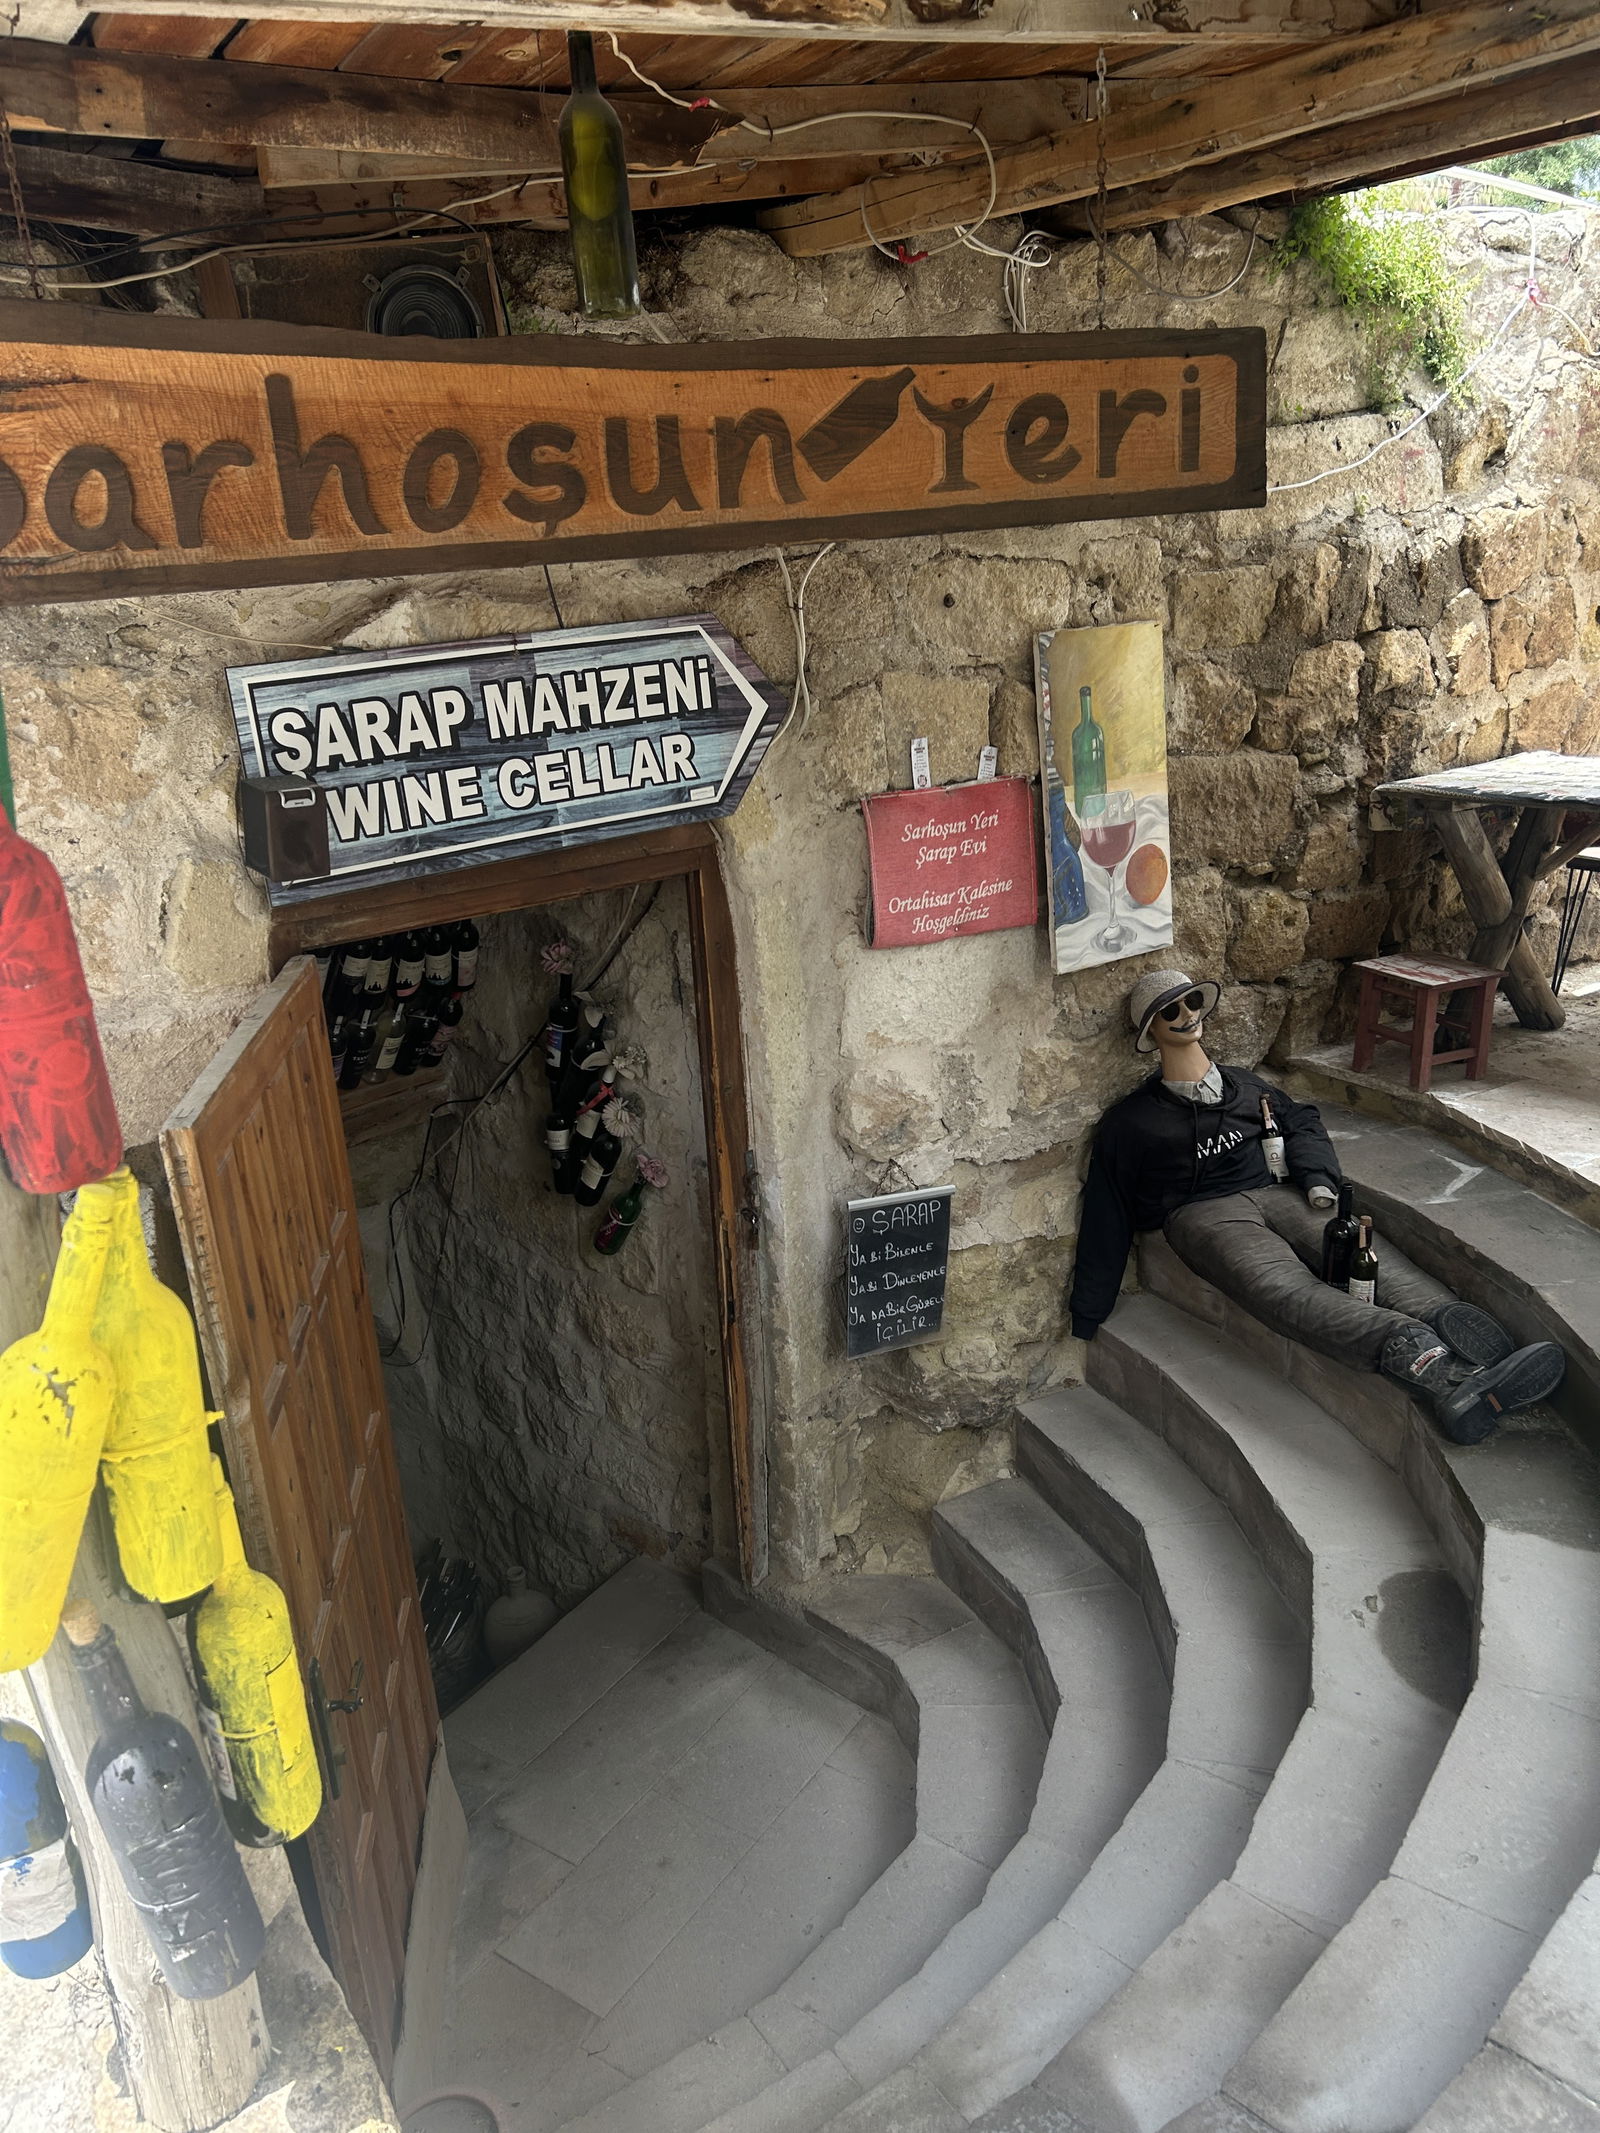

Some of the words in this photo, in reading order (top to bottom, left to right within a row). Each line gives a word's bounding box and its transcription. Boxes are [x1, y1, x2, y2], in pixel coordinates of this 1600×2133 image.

[911, 363, 1202, 493] Yeri
[271, 689, 468, 779] ŞARAP
[324, 765, 485, 841] WINE
[499, 733, 699, 809] CELLAR
[901, 818, 966, 842] Sarhoşun
[970, 808, 999, 831] Yeri
[915, 846, 957, 870] Şarap
[960, 834, 987, 857] Evi
[888, 890, 956, 914] Ortahisar
[957, 878, 1013, 905] Kalesine
[912, 904, 990, 934] Hoşgeldiniz
[872, 1199, 941, 1236] ŞARAP
